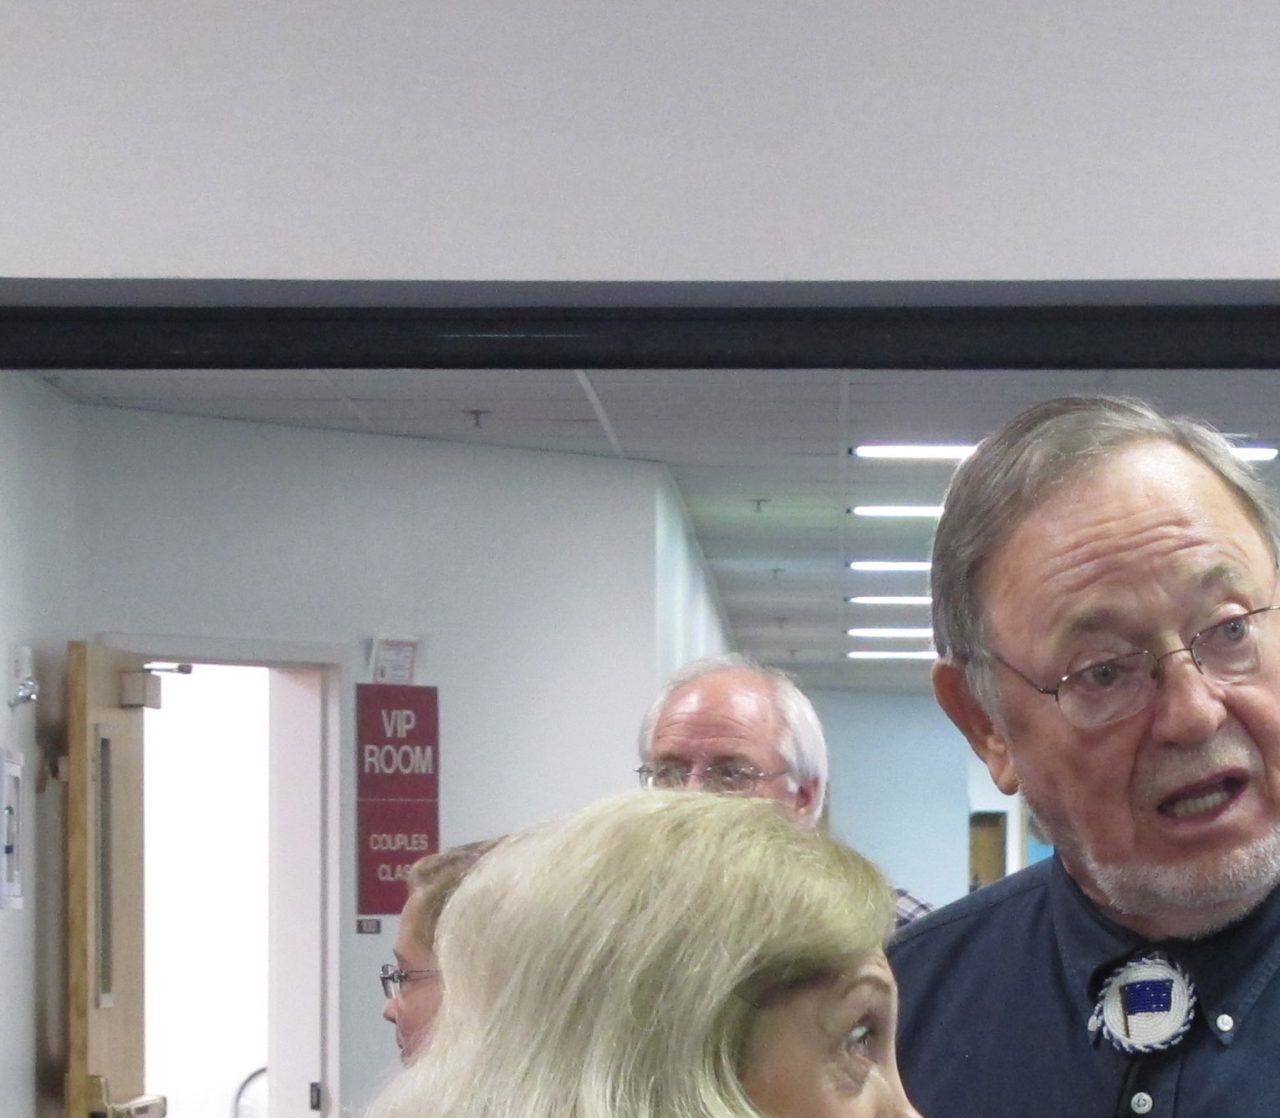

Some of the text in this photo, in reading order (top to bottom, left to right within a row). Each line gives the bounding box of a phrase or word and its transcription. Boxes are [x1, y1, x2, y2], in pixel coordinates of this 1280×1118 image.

[381, 709, 416, 738] VIP
[364, 745, 433, 774] ROOM
[369, 833, 429, 851] COUPLES
[377, 863, 413, 881] CLAS
